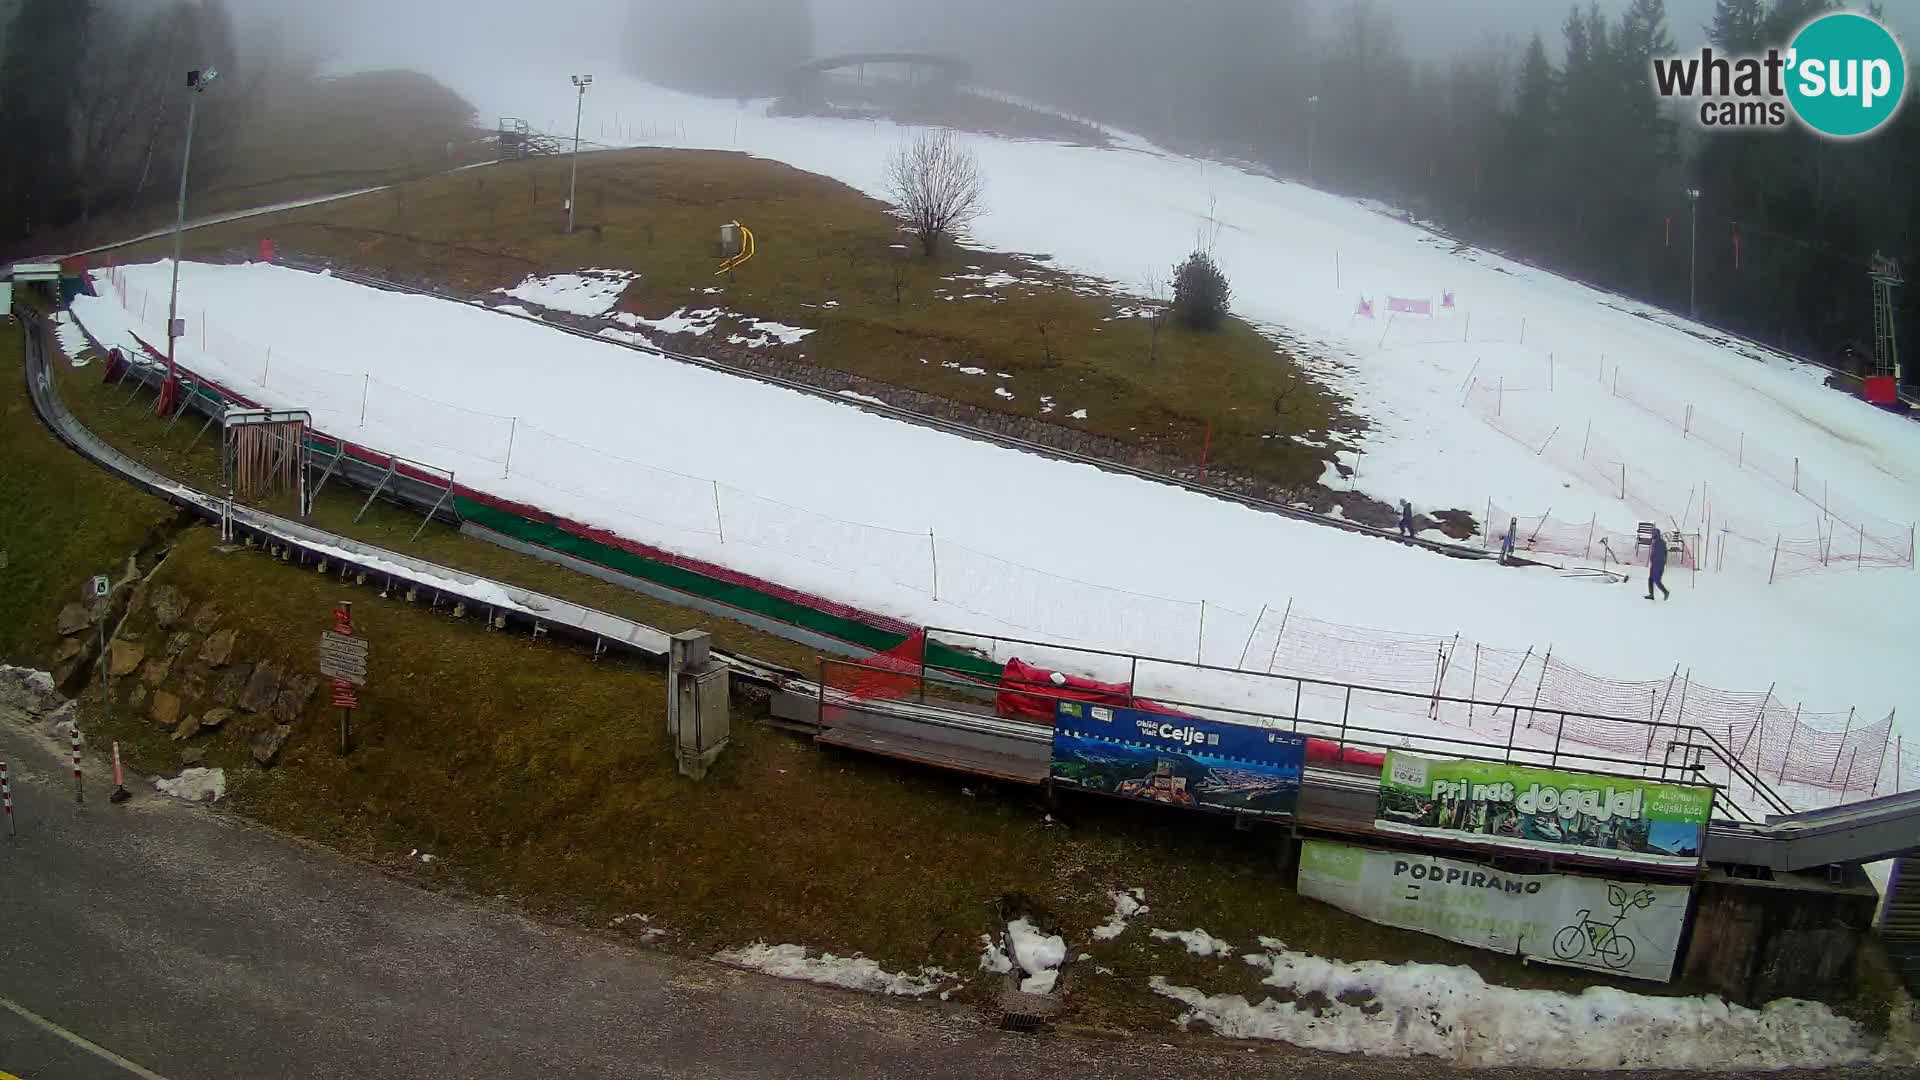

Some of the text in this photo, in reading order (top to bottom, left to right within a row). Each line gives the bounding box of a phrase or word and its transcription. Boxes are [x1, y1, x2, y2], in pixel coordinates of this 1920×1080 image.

[1159, 723, 1205, 746] Celje
[1472, 782, 1515, 802] nas
[1393, 860, 1541, 894] PODPIRAMO
